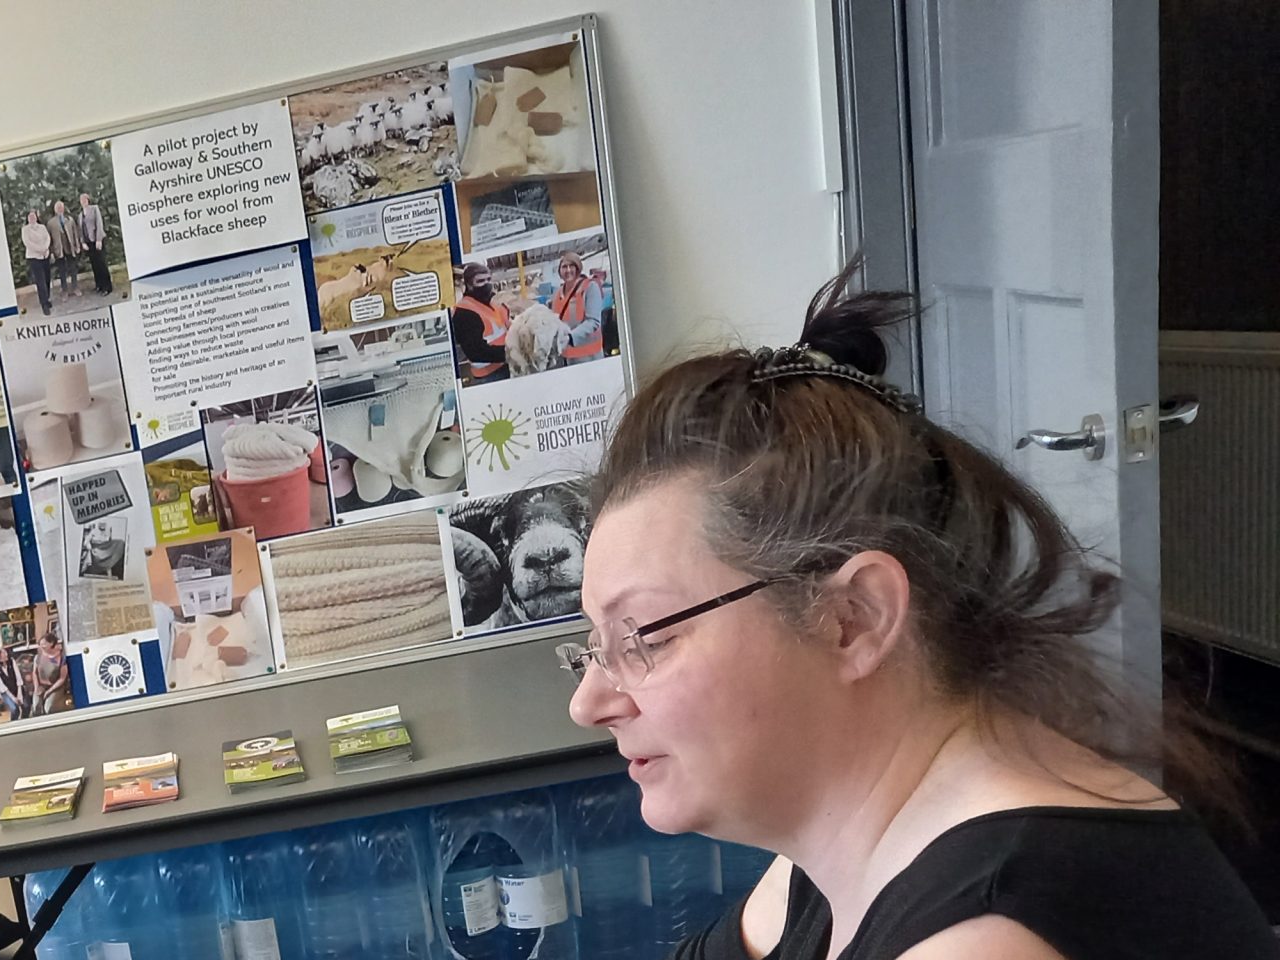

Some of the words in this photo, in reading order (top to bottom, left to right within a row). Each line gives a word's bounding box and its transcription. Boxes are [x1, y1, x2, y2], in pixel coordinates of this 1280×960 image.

[143, 144, 153, 156] A
[158, 138, 187, 156] pilot
[192, 126, 238, 149] project
[242, 123, 258, 136] by
[135, 157, 193, 176] Galloway
[198, 152, 208, 163] &
[212, 139, 272, 160] Southern
[149, 172, 203, 193] Ayrshire
[207, 157, 263, 179] UNESCO
[128, 194, 193, 216] Biosphere
[198, 180, 259, 204] exploring
[264, 172, 291, 186] new
[150, 214, 180, 228] uses
[184, 209, 203, 221] for
[206, 201, 238, 216] wool
[243, 195, 274, 209] from
[385, 214, 402, 223] Bleat
[404, 212, 411, 220] n'
[412, 207, 438, 218] Blether
[162, 222, 223, 244] Blackface
[228, 214, 267, 231] sheep
[139, 291, 162, 300] Raising
[164, 283, 198, 295] awareness
[263, 264, 279, 272] wool
[282, 260, 294, 269] and
[150, 296, 178, 309] potential
[196, 284, 233, 297] sustainable
[235, 278, 263, 288] resource
[142, 307, 178, 319] Supporting
[202, 293, 236, 306] southwest
[238, 286, 271, 297] Scotland's
[274, 281, 290, 289] most
[16, 322, 70, 339] KNITLAB
[73, 318, 110, 332] NORTH
[144, 320, 162, 328] iconic
[164, 314, 186, 323] breeds
[197, 308, 216, 316] sheep
[145, 325, 181, 337] Connecting
[183, 311, 243, 329] farmers/producers
[245, 307, 259, 315] with
[261, 301, 289, 311] creatives
[161, 332, 196, 343] businesses
[197, 325, 223, 335] working
[241, 316, 257, 325] wool
[148, 347, 171, 356] Adding
[173, 342, 190, 350] value
[192, 336, 218, 345] through
[220, 331, 235, 339] local
[237, 324, 275, 337] provenance
[277, 318, 289, 327] and
[149, 356, 171, 364] finding
[200, 345, 222, 354] reduce
[224, 340, 243, 348] waste
[45, 350, 56, 361] IN
[64, 342, 102, 363] BRITAIN
[151, 364, 178, 374] Creating
[213, 348, 249, 360] marketable
[265, 339, 285, 349] useful
[286, 336, 305, 344] items
[154, 381, 187, 392] Promoting
[201, 373, 224, 382] history
[226, 368, 238, 376] and
[240, 362, 266, 373] heritage
[155, 390, 186, 401] important
[189, 385, 203, 394] rural
[205, 380, 231, 390] industry
[534, 398, 582, 417] GALLOWAY
[586, 393, 606, 406] AND
[535, 414, 572, 430] SOUTHERN
[574, 406, 607, 421] AYRSHIRE
[69, 478, 106, 495] HAPPED
[72, 496, 85, 506] UP
[88, 491, 98, 501] IN
[77, 495, 125, 518] MEMORIES
